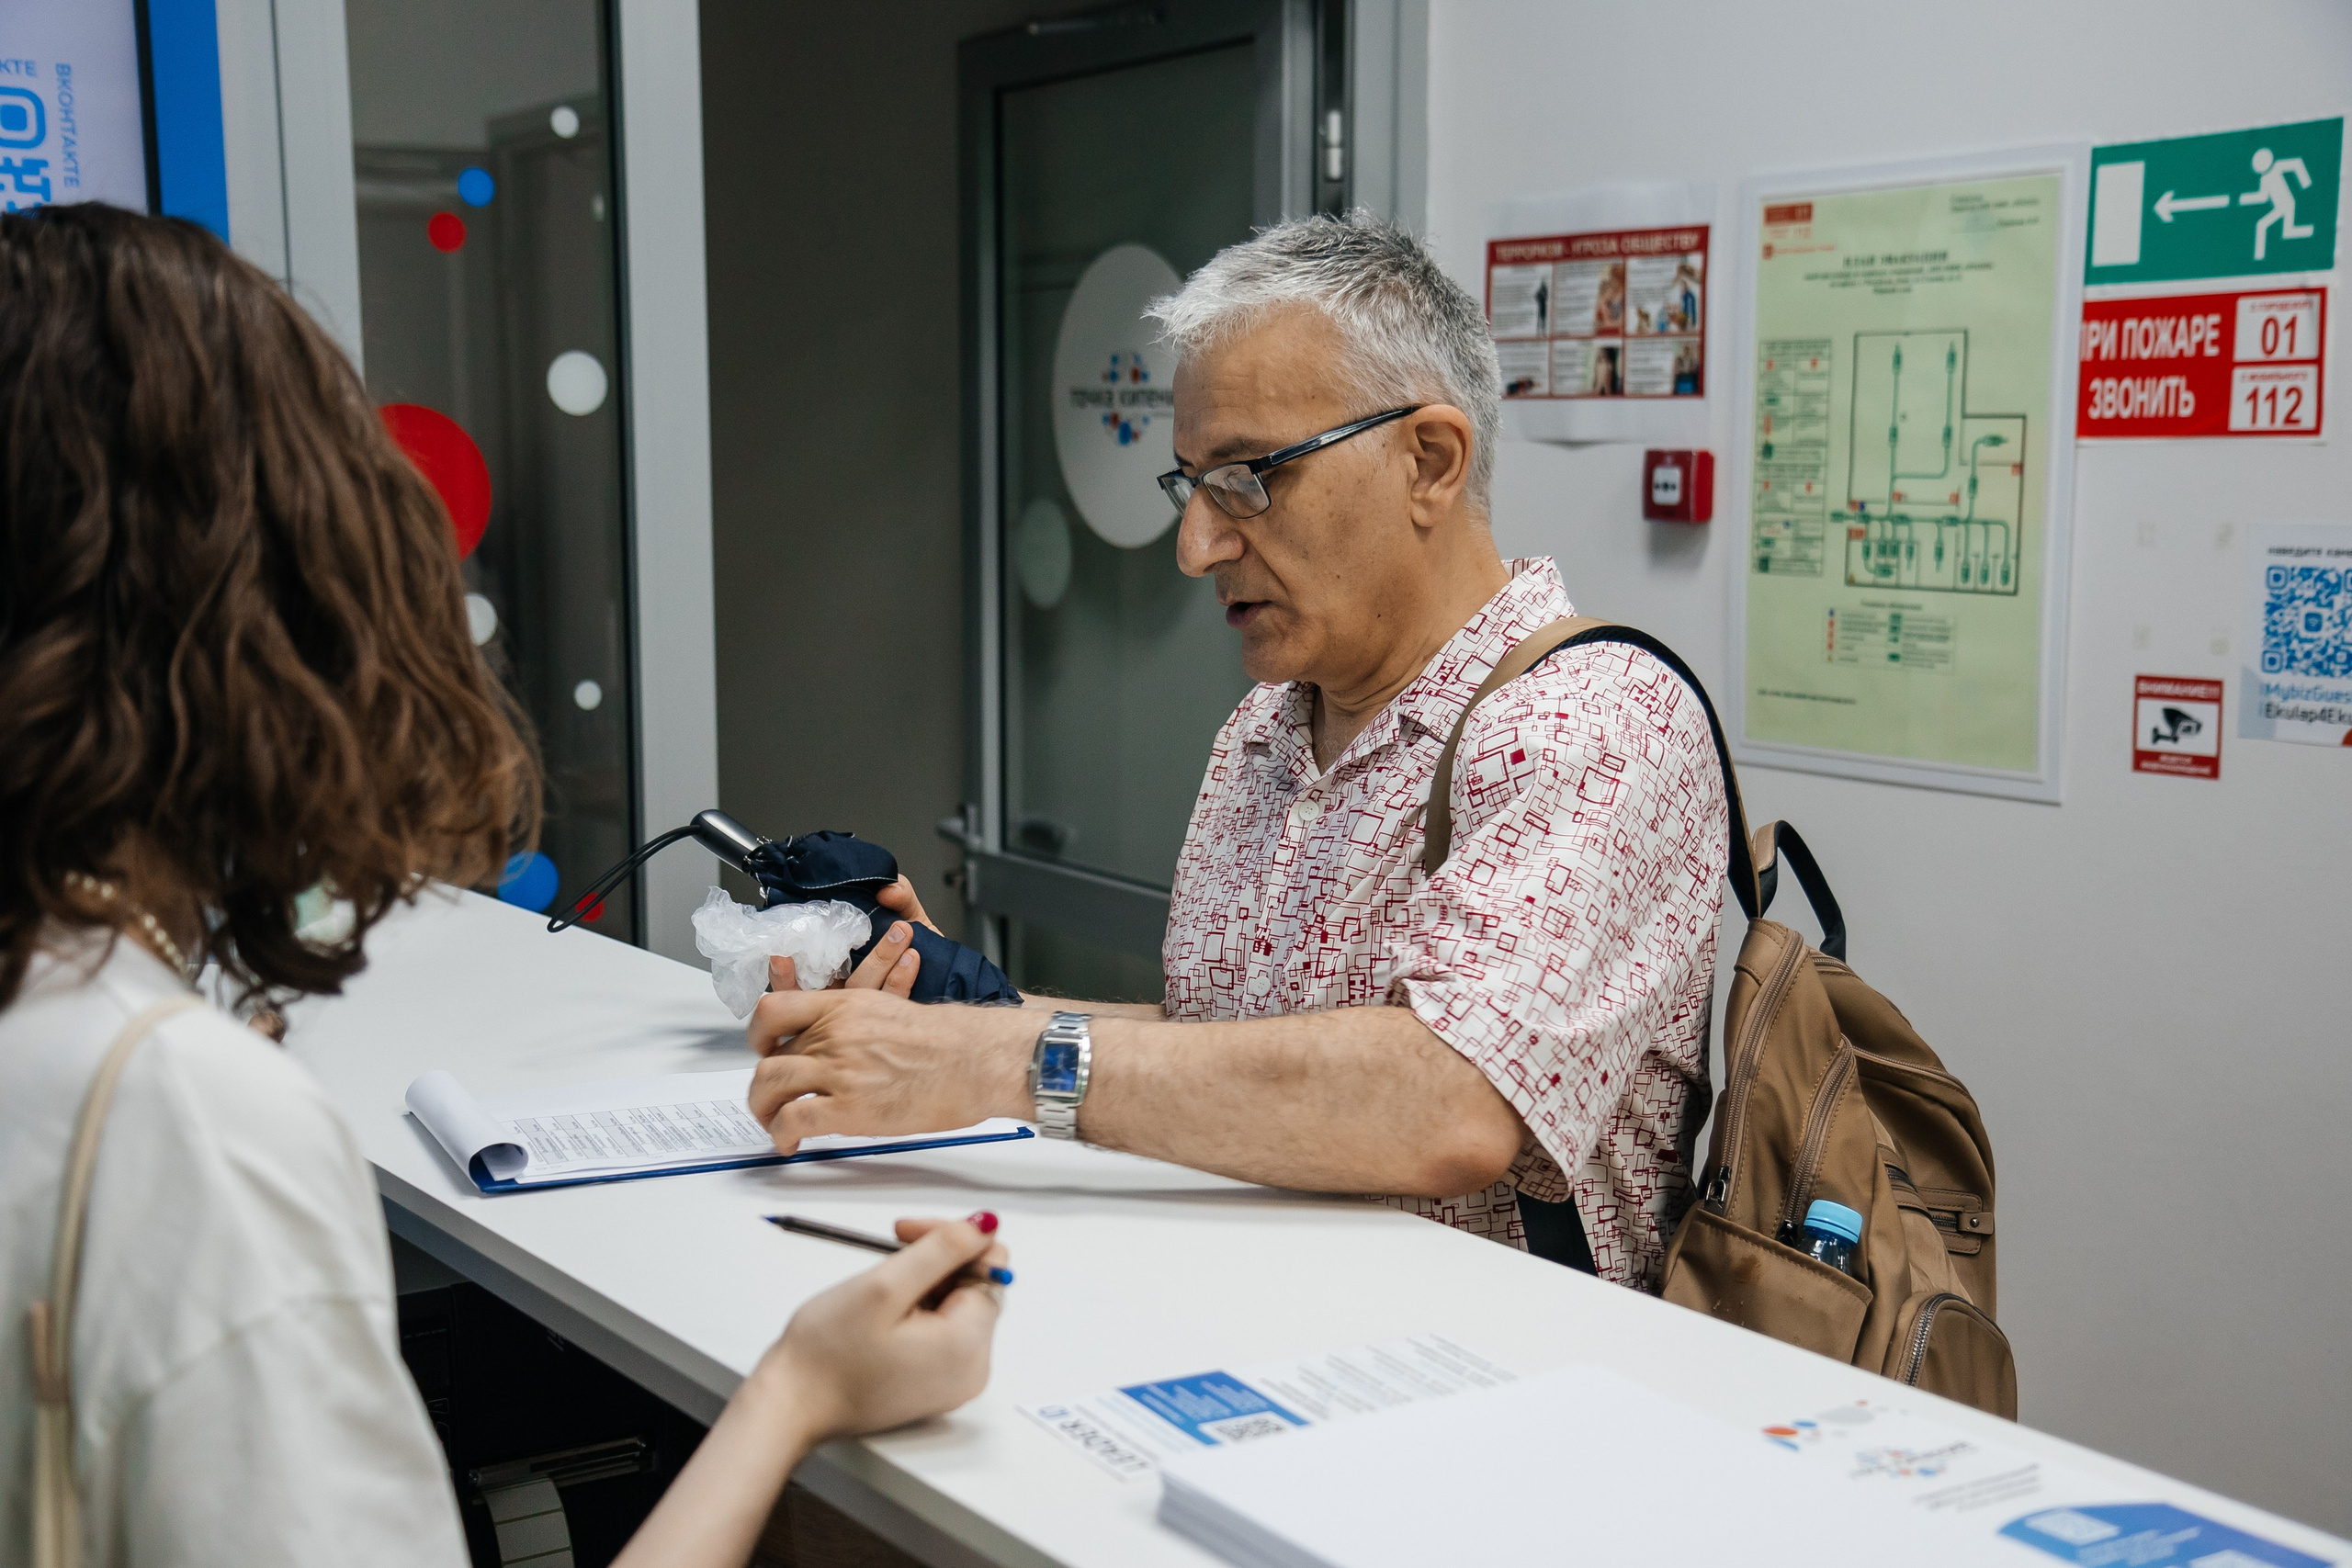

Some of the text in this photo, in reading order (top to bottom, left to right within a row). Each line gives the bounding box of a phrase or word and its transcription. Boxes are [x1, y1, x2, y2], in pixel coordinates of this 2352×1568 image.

[55, 62, 80, 187] ВКОНТАКТЕ
[2120, 313, 2222, 359] ПОЖАРЕ
[2261, 314, 2298, 357] 01
[2087, 376, 2196, 420] ЗВОНИТЬ
[2245, 386, 2303, 425] 112
